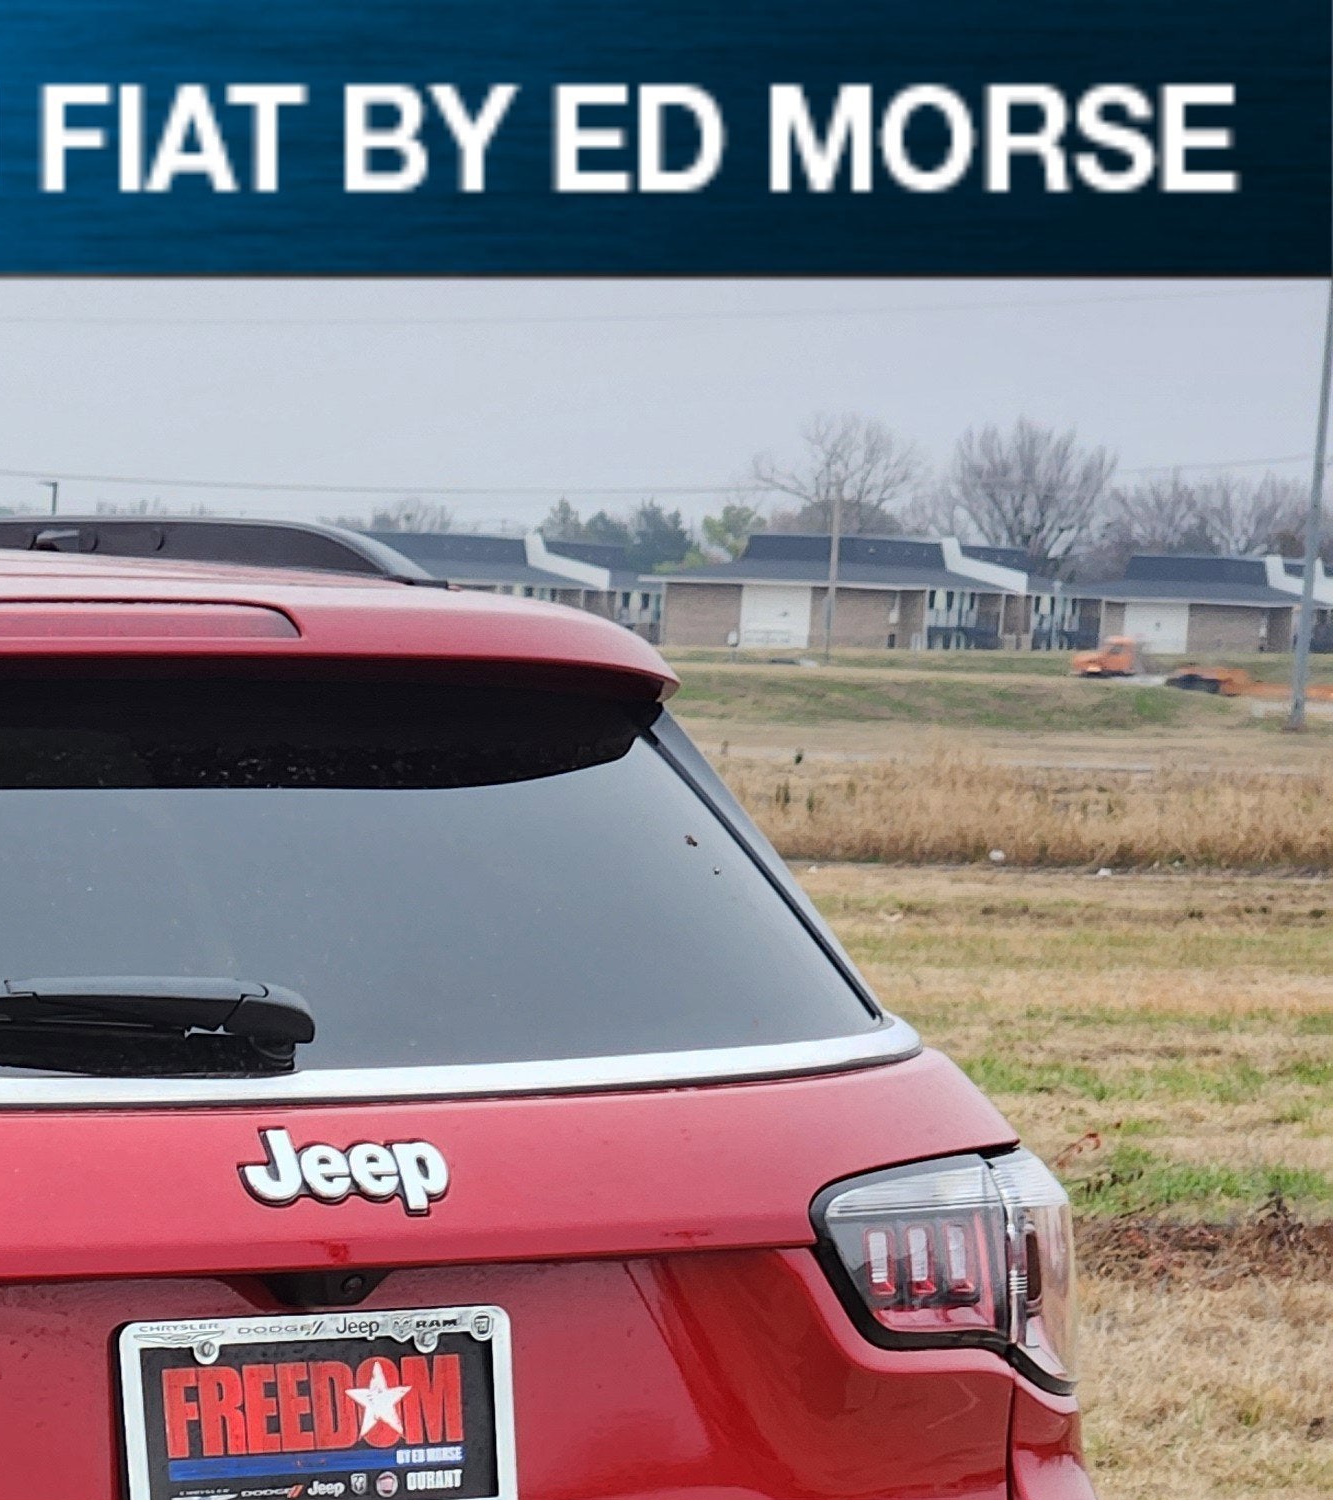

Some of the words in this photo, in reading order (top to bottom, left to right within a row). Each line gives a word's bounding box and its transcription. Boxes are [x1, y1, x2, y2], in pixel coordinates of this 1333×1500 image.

[237, 1126, 449, 1217] Jeep
[139, 1322, 219, 1333] CHRYSLER
[237, 1324, 312, 1334] DODGE
[336, 1317, 380, 1338] Jeep
[415, 1318, 458, 1328] RAM
[162, 1354, 464, 1459] FREEDOM
[308, 1480, 346, 1498] Jeep
[406, 1469, 463, 1491] DURANT
